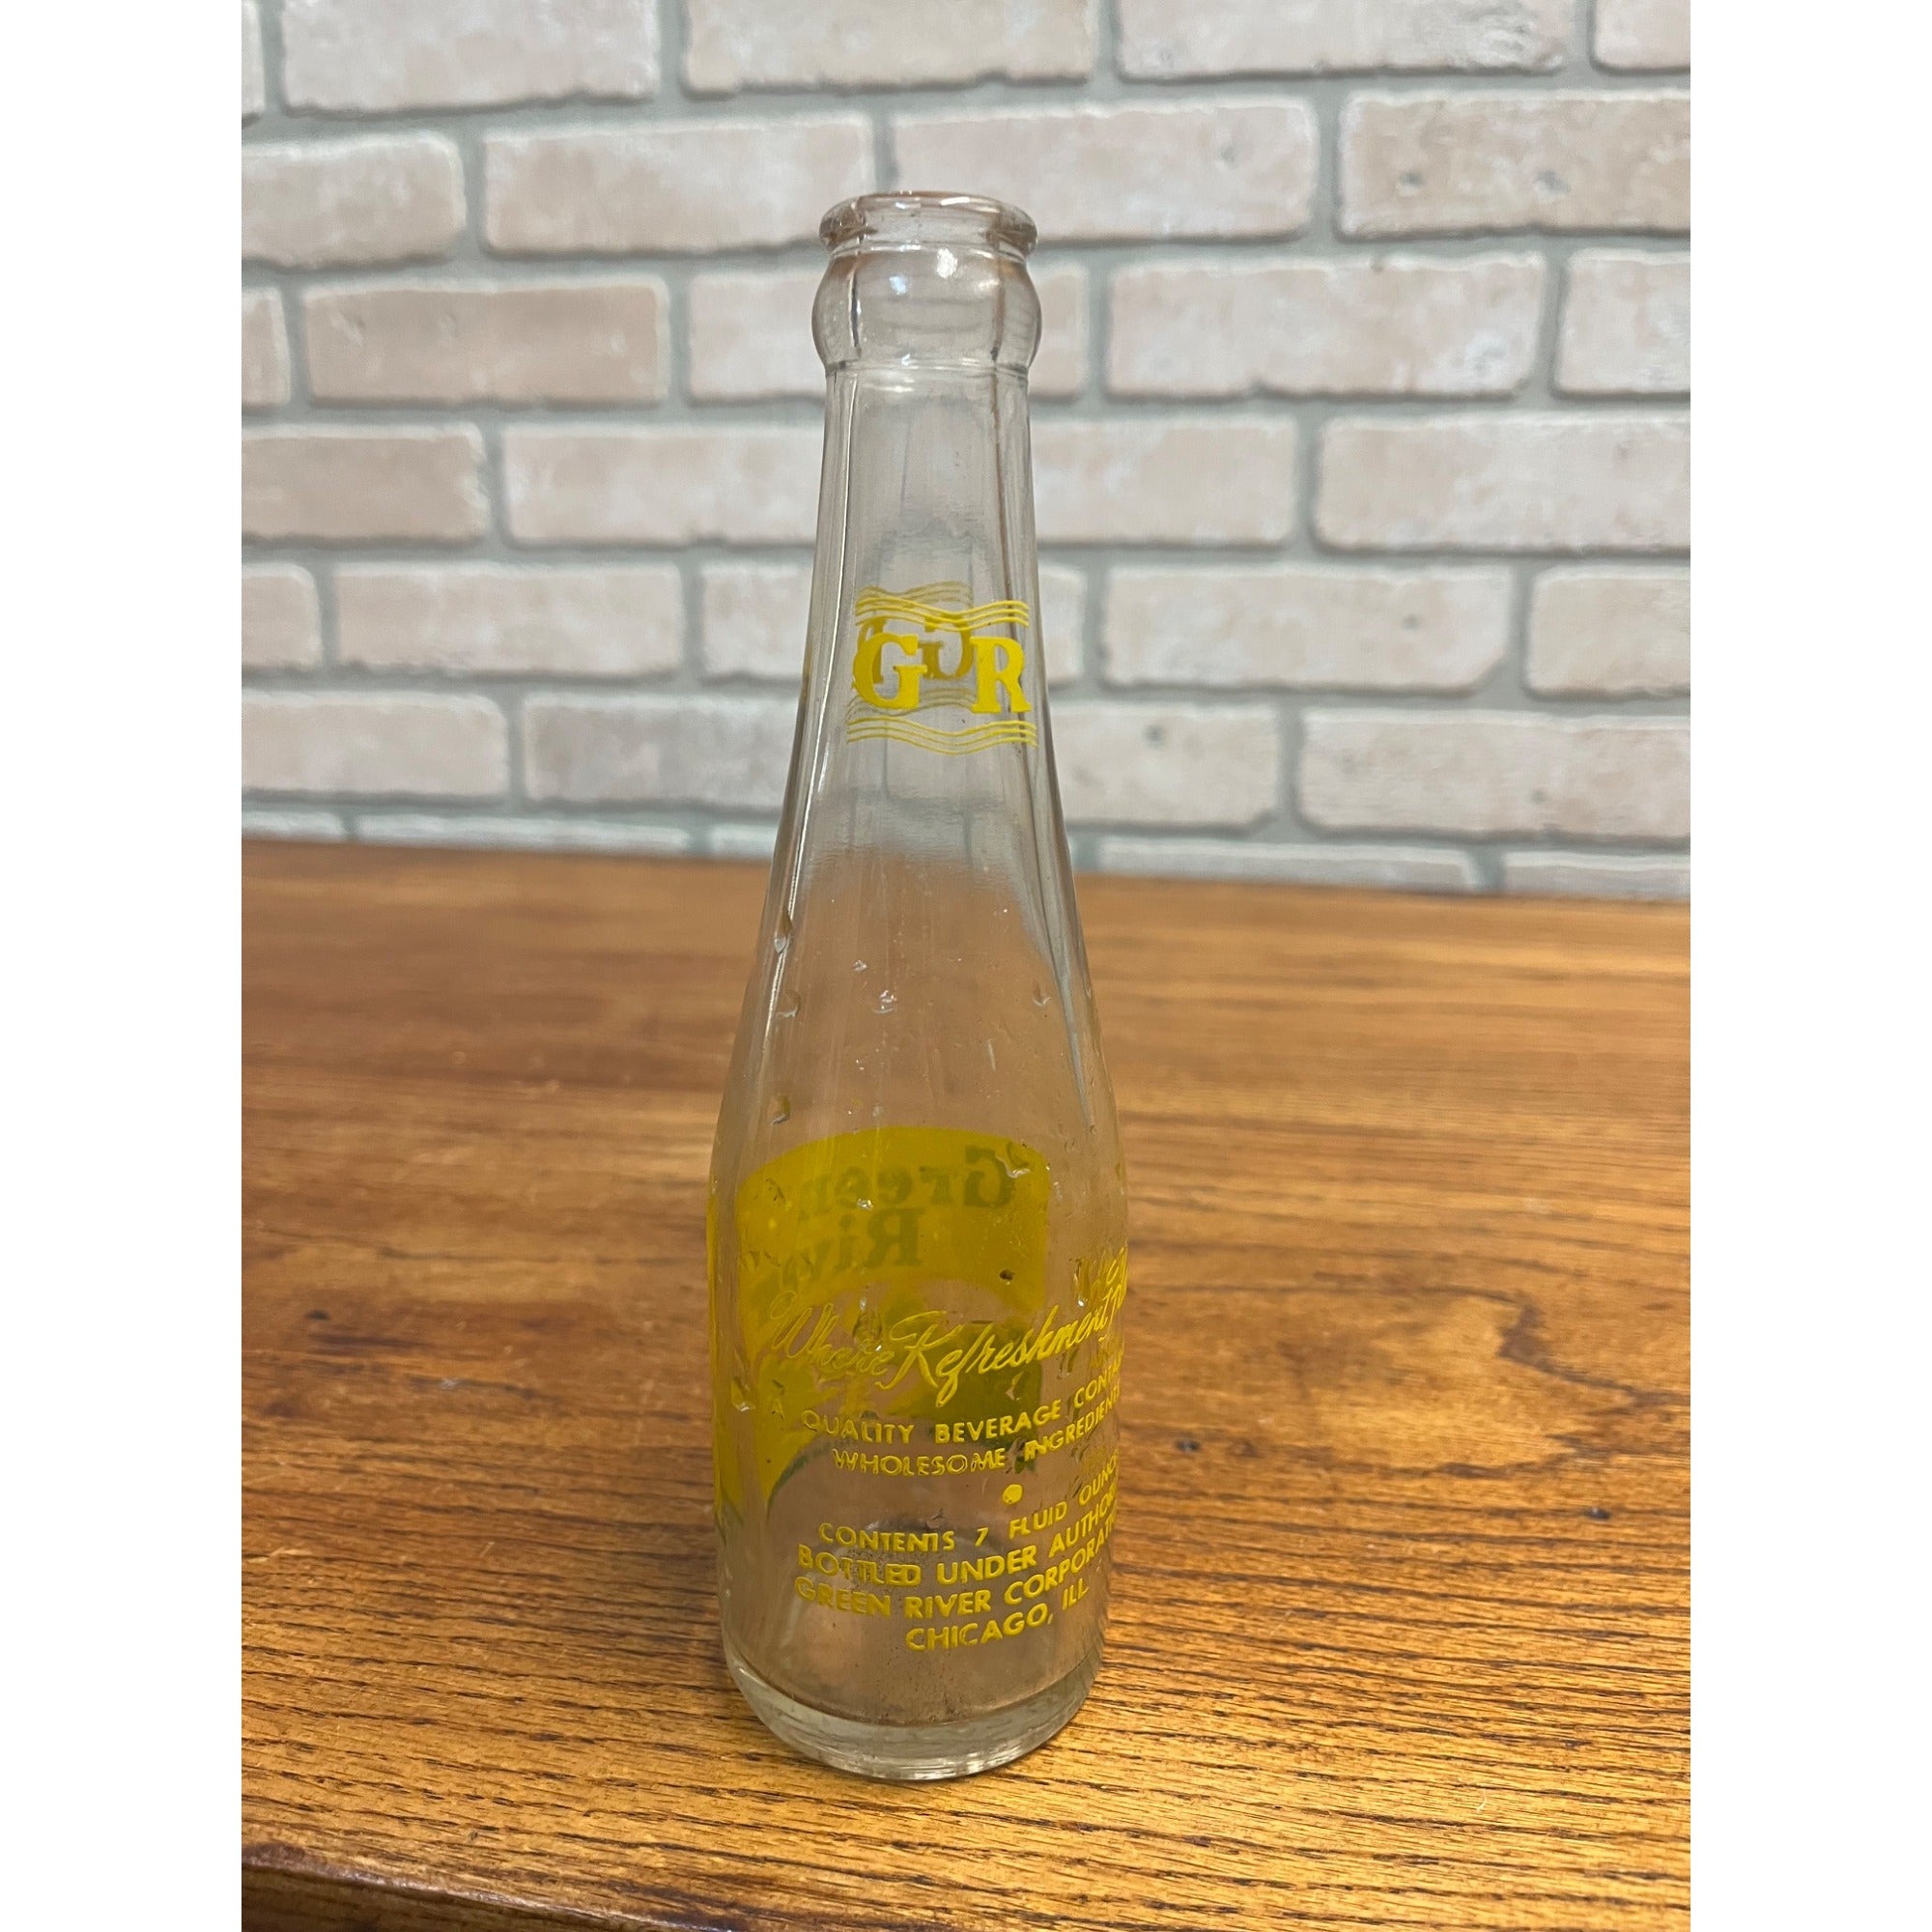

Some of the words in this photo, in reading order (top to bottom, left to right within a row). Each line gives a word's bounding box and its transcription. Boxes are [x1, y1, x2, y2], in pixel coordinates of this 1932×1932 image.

[801, 1408, 915, 1444] QUALITY
[935, 1398, 1062, 1445] BEVERAGE
[832, 1447, 1006, 1477] WHOLESOME
[819, 1522, 954, 1553] CONTENTS
[975, 1527, 989, 1548] 7
[1009, 1501, 1067, 1540] FLUID
[798, 1545, 922, 1587] BOTTLED
[936, 1545, 1037, 1586] UNDER
[794, 1576, 891, 1620] GREEN
[904, 1589, 992, 1619] RIVER
[905, 1602, 1054, 1653] CHICAGO,
[1062, 1577, 1090, 1611] ILL
